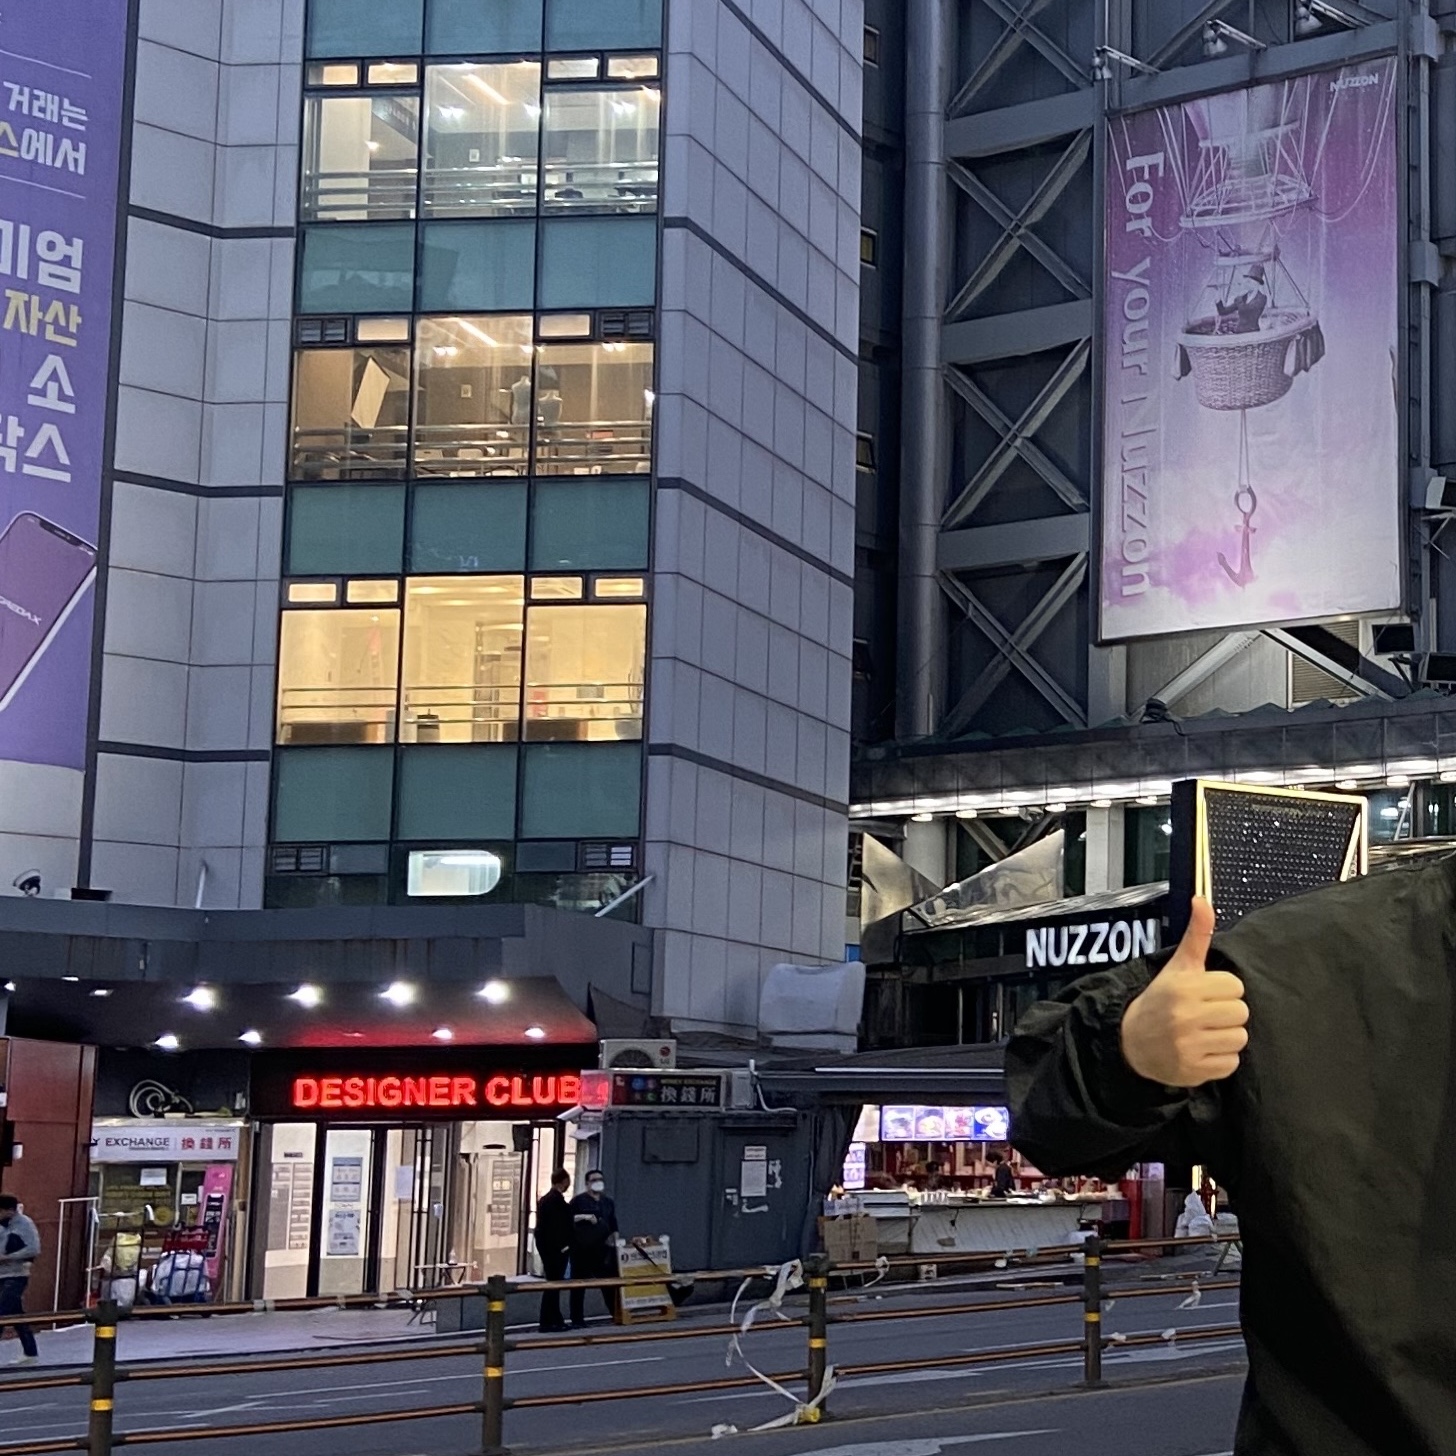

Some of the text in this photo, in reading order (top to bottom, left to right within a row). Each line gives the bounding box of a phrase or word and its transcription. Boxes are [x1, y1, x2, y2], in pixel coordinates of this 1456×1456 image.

[3, 80, 89, 131] 거래는
[1329, 73, 1379, 92] NUZZON
[3, 289, 82, 348] 자산
[27, 354, 76, 415] 소
[1111, 152, 1165, 597] For your Nuzzon
[1026, 918, 1156, 968] NUZZON
[293, 1075, 582, 1107] DESIGNER CLUB
[105, 1137, 170, 1147] EXCHANGE
